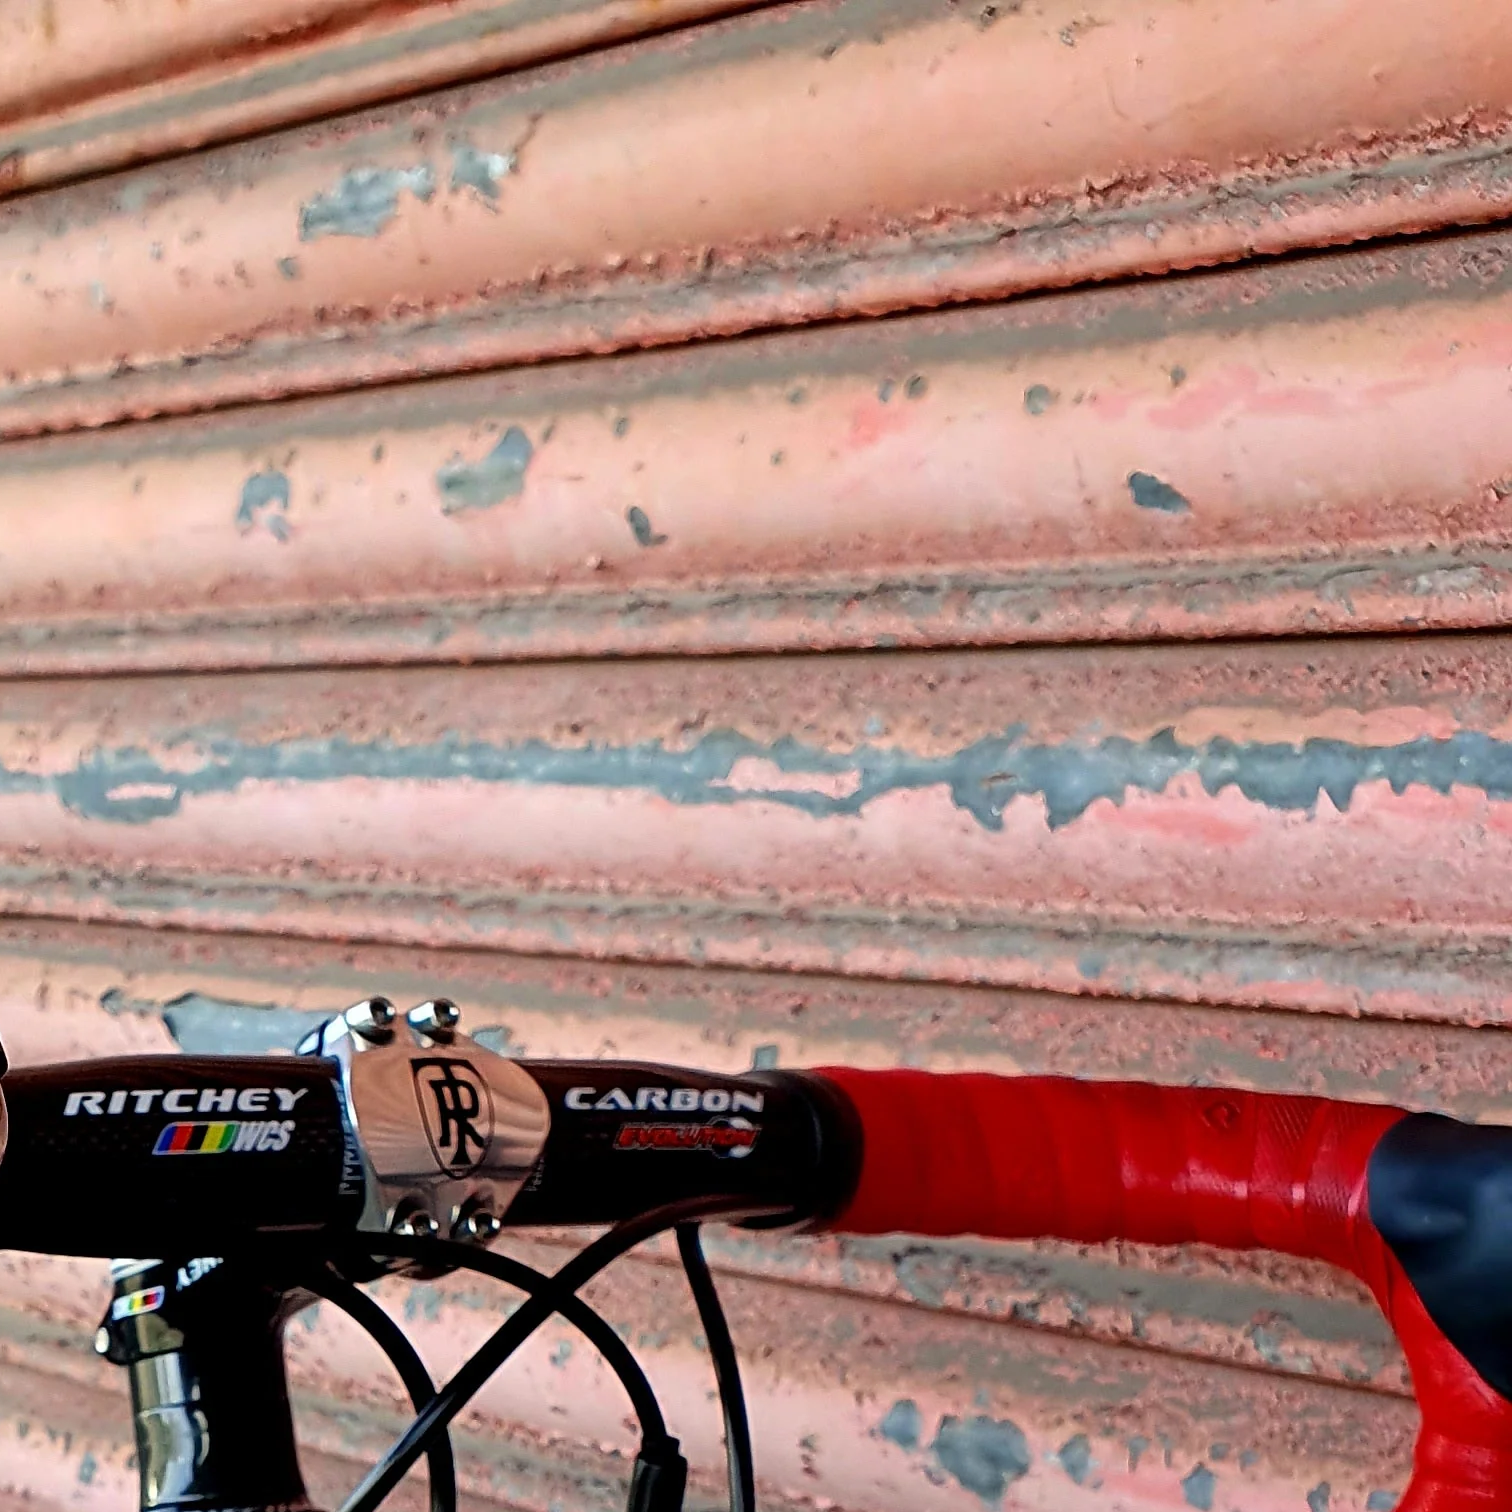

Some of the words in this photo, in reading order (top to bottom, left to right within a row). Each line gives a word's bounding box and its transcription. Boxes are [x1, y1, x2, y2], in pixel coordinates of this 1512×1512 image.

[63, 1088, 309, 1116] RITCHEY
[564, 1086, 765, 1113] CARBON
[231, 1120, 296, 1152] WCS
